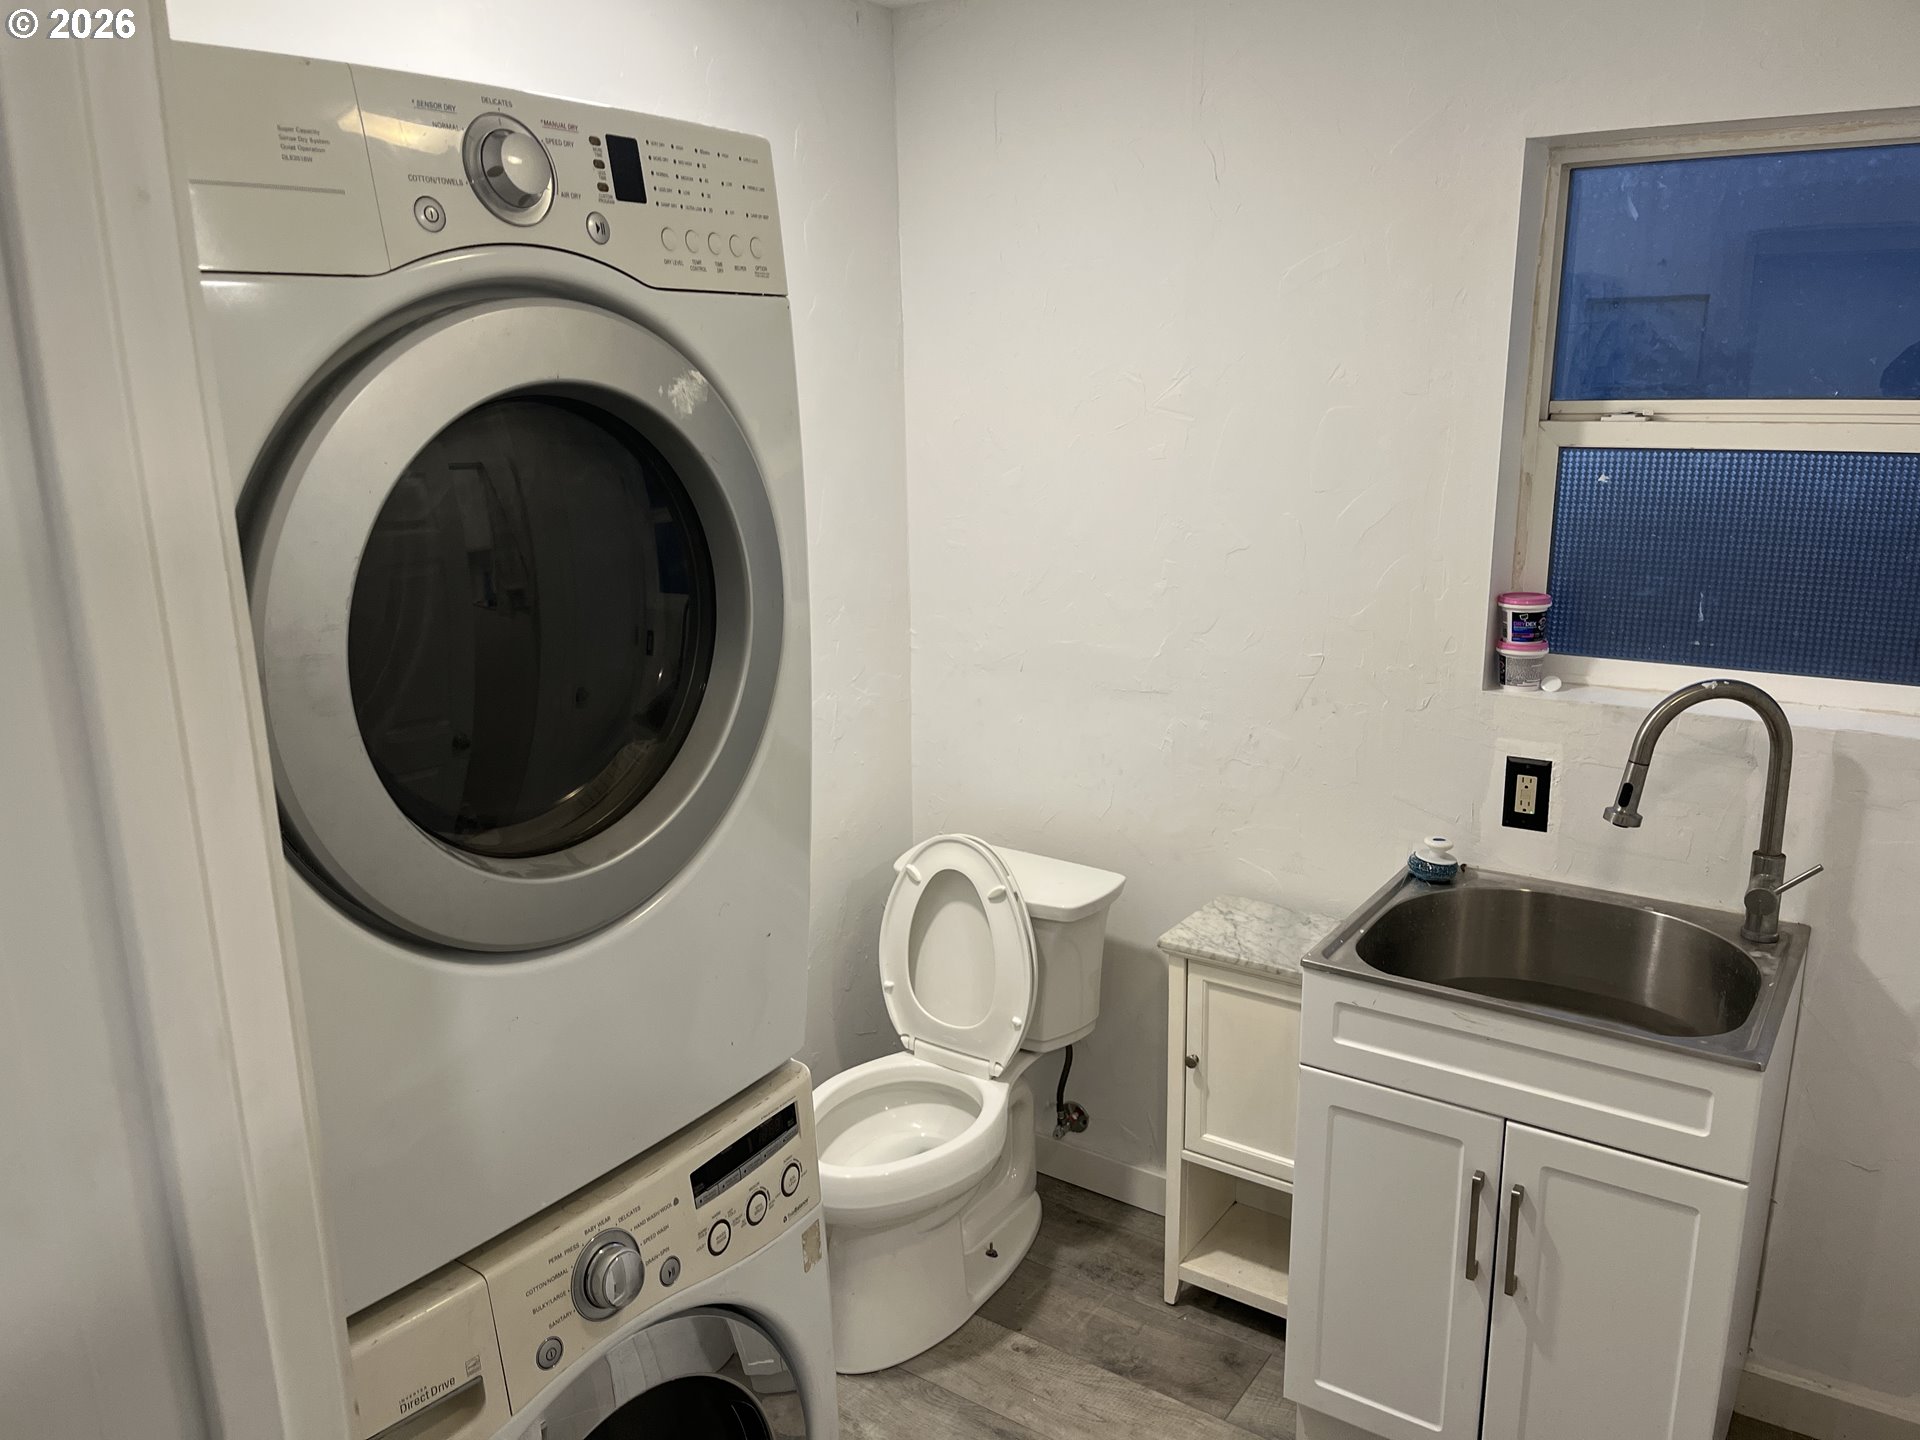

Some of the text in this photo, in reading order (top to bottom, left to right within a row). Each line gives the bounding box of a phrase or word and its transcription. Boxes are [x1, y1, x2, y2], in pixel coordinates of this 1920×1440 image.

[416, 100, 457, 112] SENSOR DRY
[481, 96, 513, 108] DELICATES
[295, 126, 320, 136] Capacity
[432, 121, 459, 131] NORMAL
[543, 119, 579, 131] MANUAL DRY
[297, 145, 325, 153] Operation
[544, 137, 575, 148] SPEED DRY
[407, 174, 464, 187] COTTON/TOWELS
[560, 191, 581, 200] AIR DRY
[617, 1205, 642, 1224] DELICATES
[584, 1215, 612, 1236] BABY WEAR
[633, 1218, 647, 1231] HAND
[643, 1223, 670, 1247] SPEED WASH
[564, 1242, 580, 1256] PRESS
[525, 1268, 569, 1298] COTTON/NORMAL
[532, 1290, 567, 1316] BULKY/LARGE
[548, 1310, 573, 1331] SANITARY
[399, 1376, 457, 1415] Direct Drive
